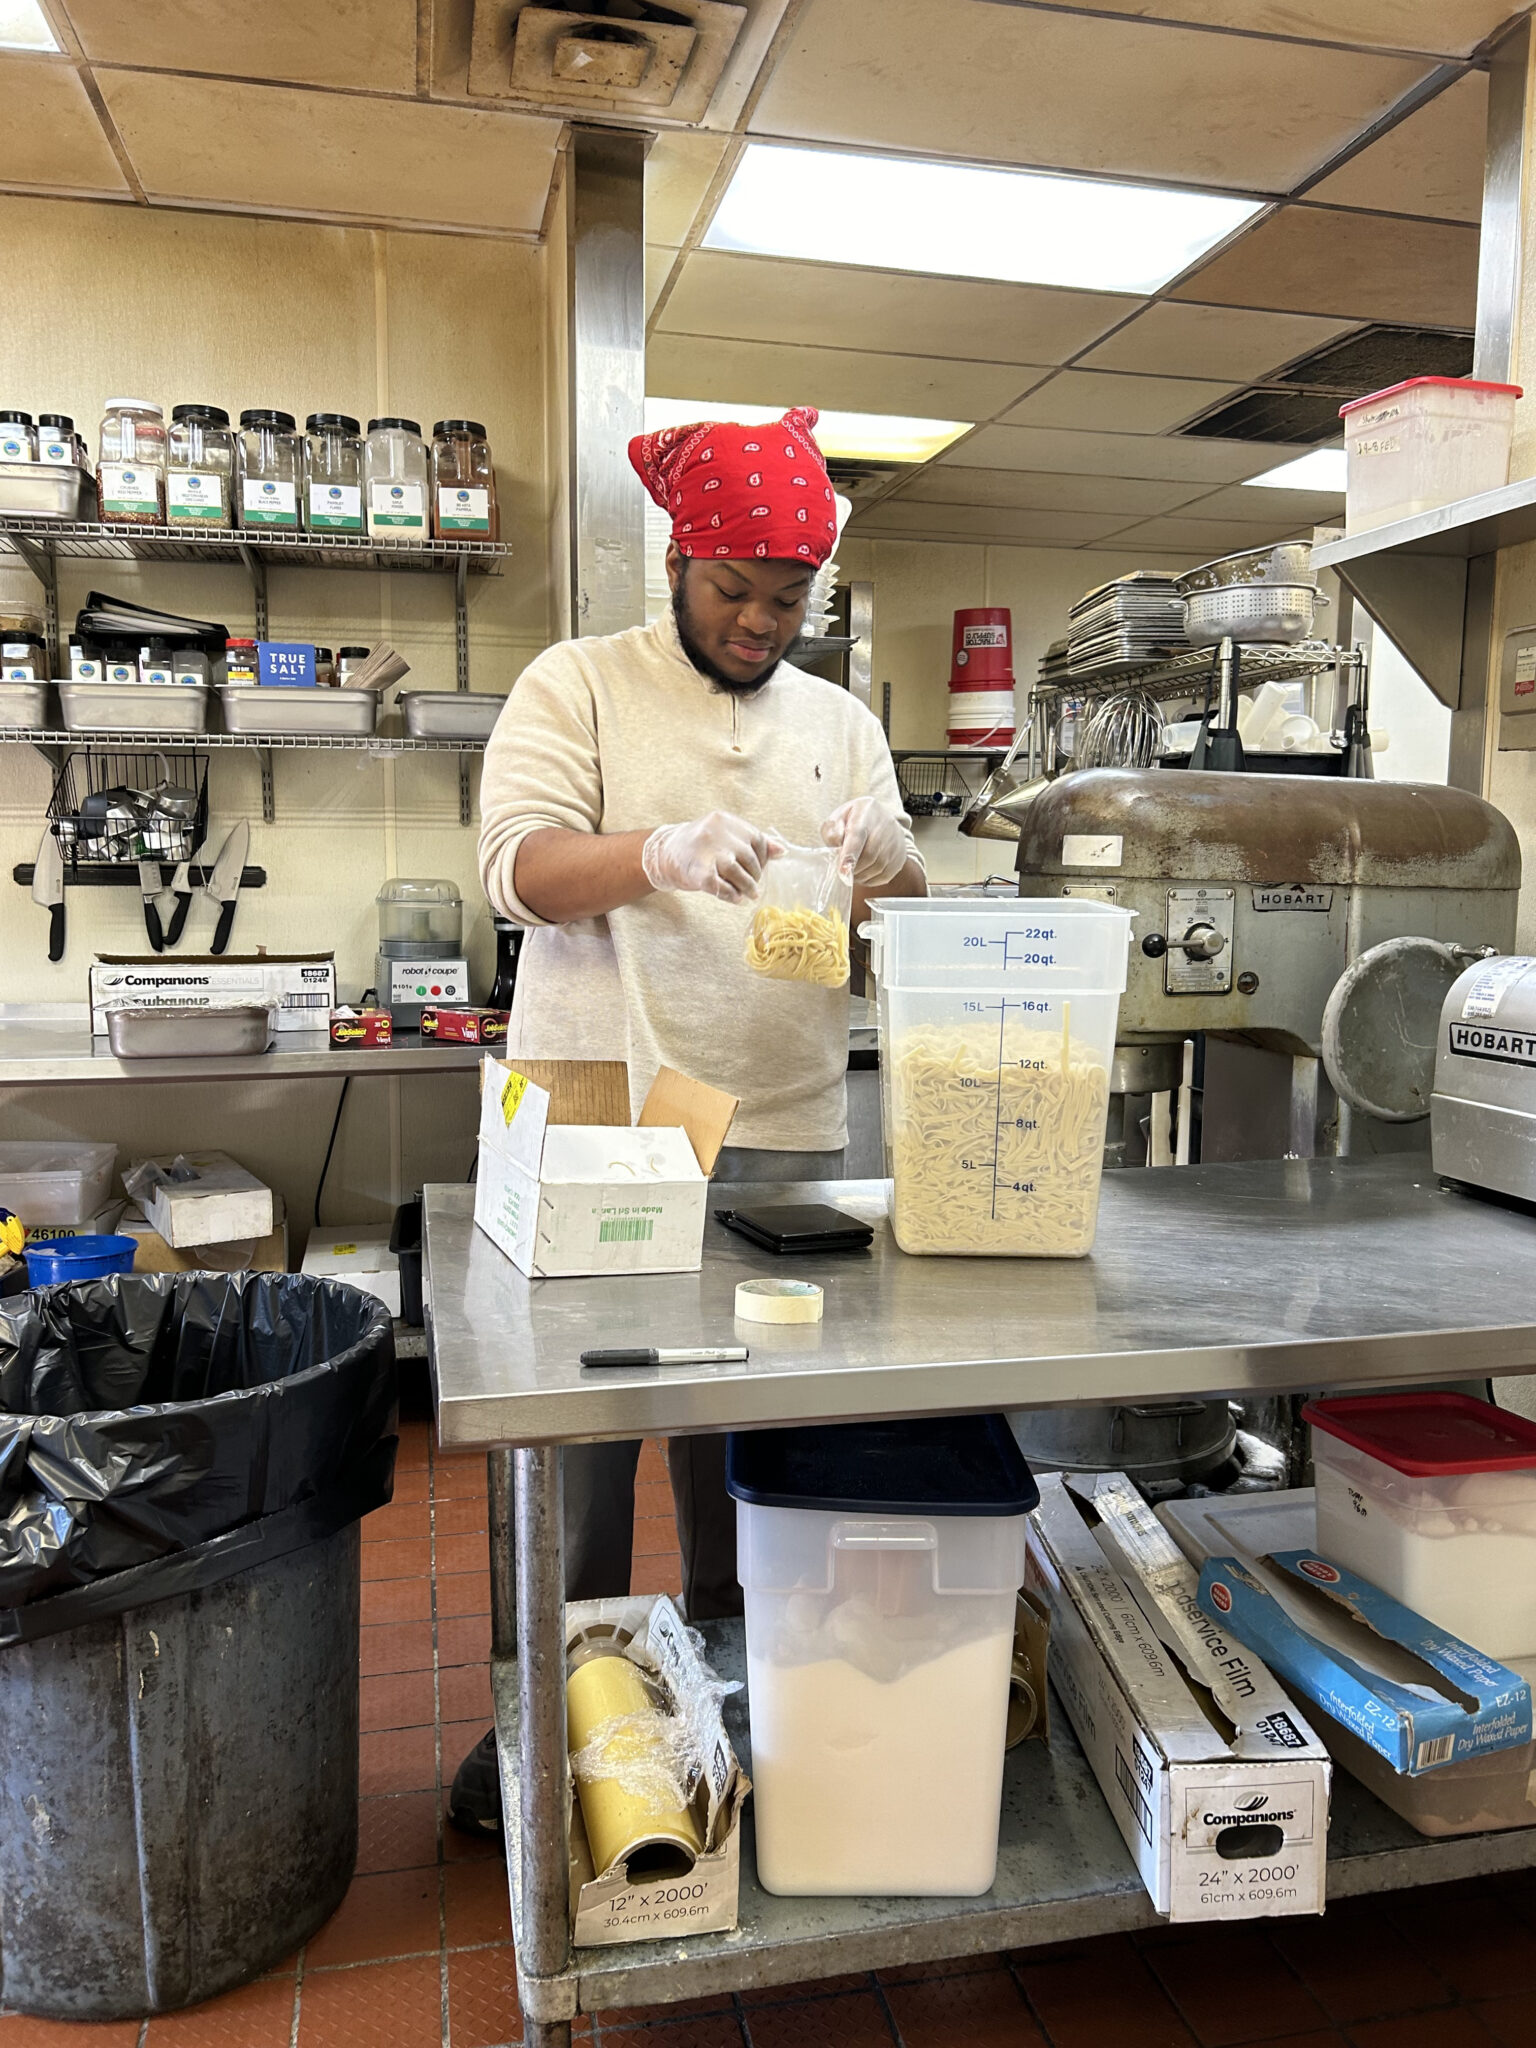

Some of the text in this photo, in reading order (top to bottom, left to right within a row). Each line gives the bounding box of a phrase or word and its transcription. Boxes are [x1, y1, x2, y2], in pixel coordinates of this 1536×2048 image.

[965, 639, 997, 647] TRACTOR
[269, 652, 306, 664] TRUE
[270, 663, 306, 675] SALT
[1261, 894, 1325, 904] HOBART
[1208, 916, 1216, 924] 3
[963, 937, 987, 947] 20L
[401, 967, 458, 976] robot coupe
[124, 975, 260, 988] Companions ESSENTIALS
[963, 1001, 985, 1012] 15L
[461, 1027, 478, 1041] Vinyl
[1456, 1029, 1536, 1056] HOBART
[960, 1078, 981, 1088] 10L
[961, 1160, 977, 1169] 5L
[618, 1207, 630, 1215] Sri
[641, 1206, 663, 1214] Made
[31, 1228, 76, 1240] 46100
[1102, 1611, 1117, 1631] Cutting
[1113, 1630, 1125, 1645] Edge
[1120, 1612, 1140, 1635] 61cm
[1138, 1643, 1165, 1678] 609.6m
[1420, 1639, 1440, 1652] Dry
[1438, 1647, 1475, 1670] Waxed
[1445, 1640, 1501, 1674] Interfolded
[1219, 1656, 1256, 1698] Film
[1496, 1689, 1528, 1708] EZ-12
[1329, 1689, 1375, 1735] Interfolded
[1363, 1699, 1396, 1729] EZ-12
[1271, 1715, 1302, 1747] 18687
[1319, 1691, 1392, 1759] Dry Waxed Paper
[1472, 1711, 1517, 1735] Interfolded
[1457, 1738, 1475, 1752] Dry
[1475, 1727, 1504, 1746] Waxed
[1504, 1723, 1529, 1739] Paper
[1203, 1810, 1294, 1827] Companions
[1199, 1864, 1300, 1887] 24" x 2000'
[609, 1882, 708, 1912] 12" x 2000'
[1200, 1887, 1298, 1904] 61cm x 609.6m
[603, 1905, 710, 1928] 30.4cm x 609.6m
